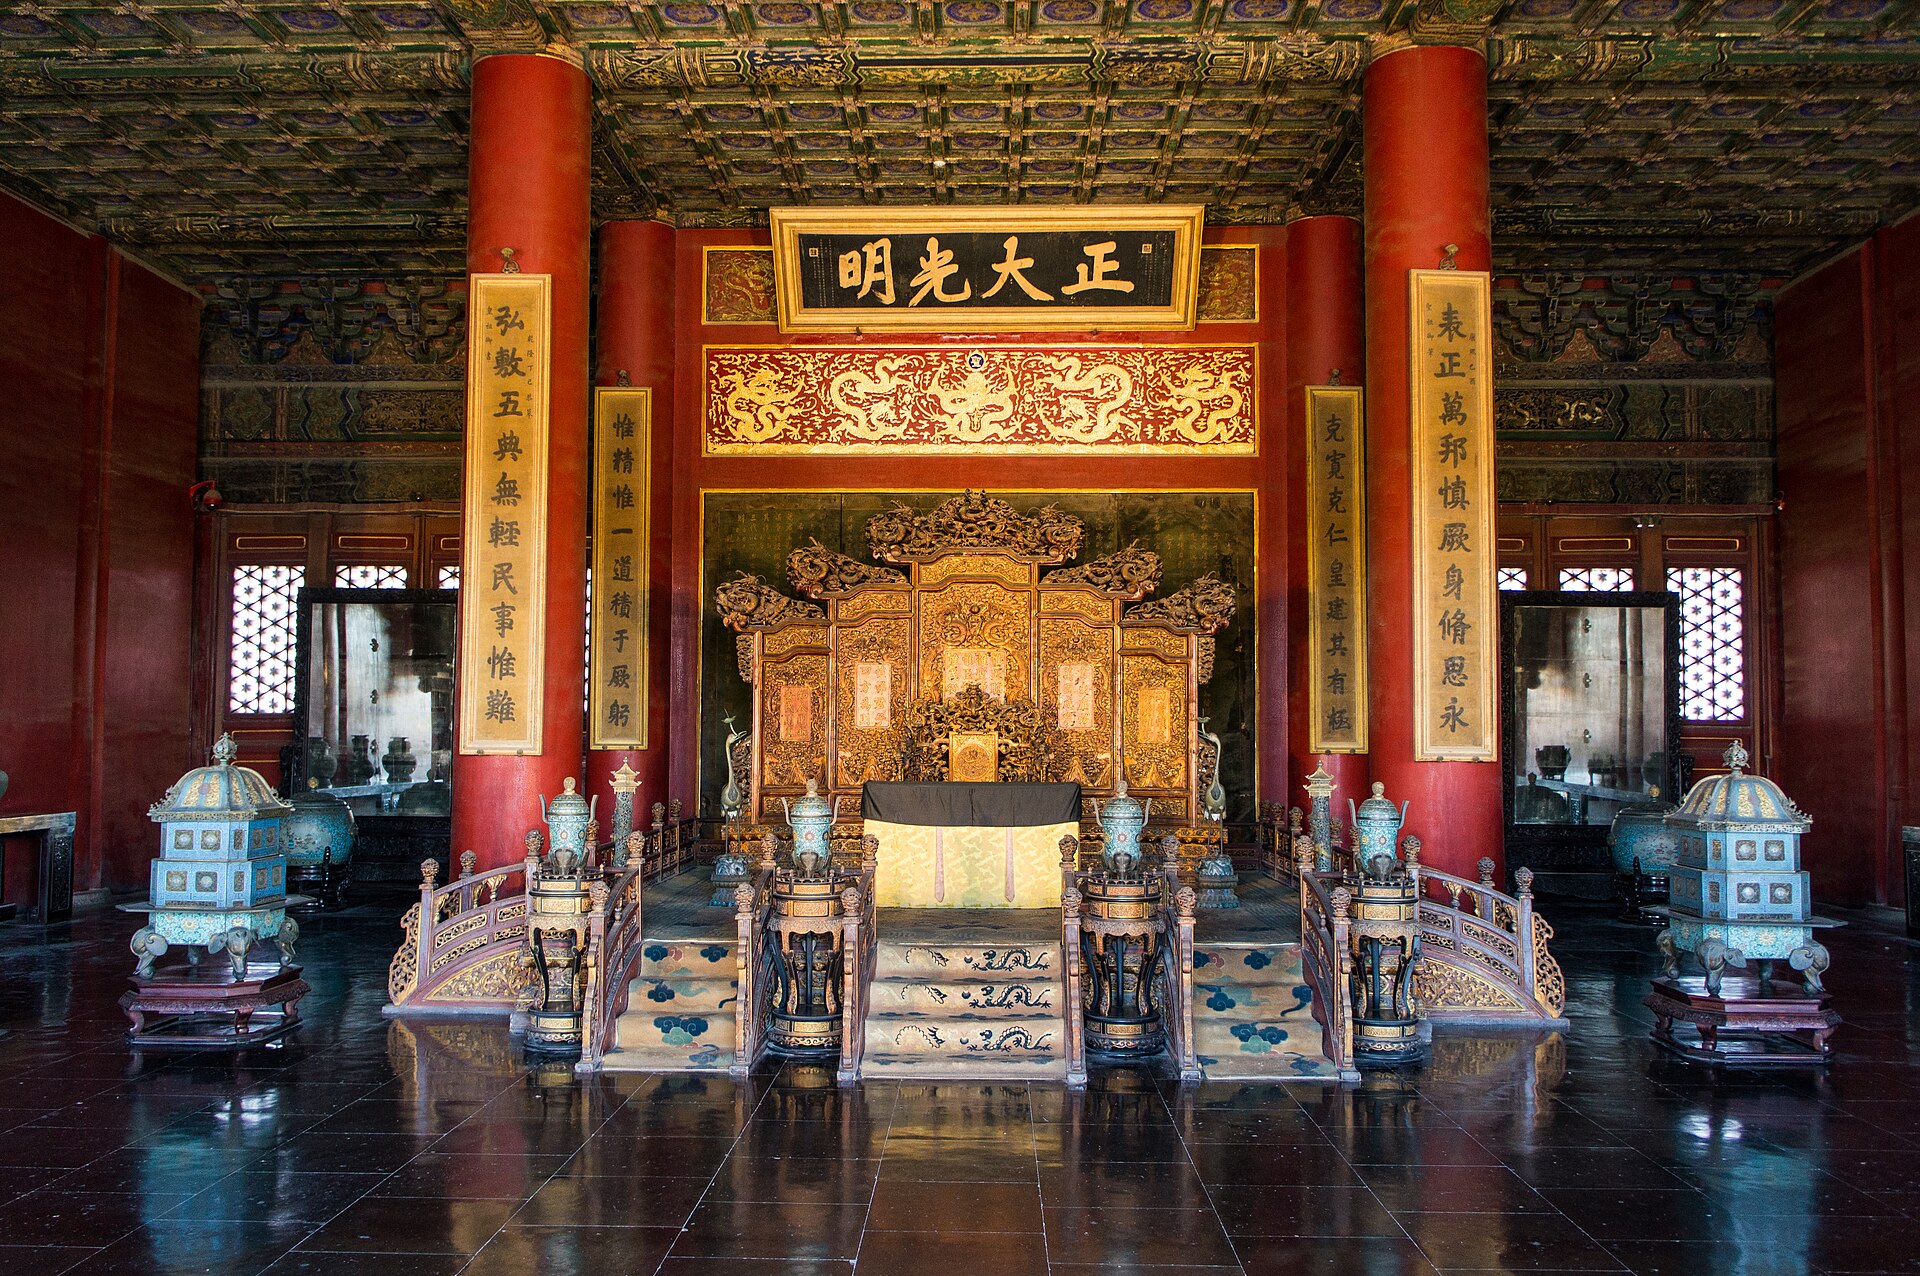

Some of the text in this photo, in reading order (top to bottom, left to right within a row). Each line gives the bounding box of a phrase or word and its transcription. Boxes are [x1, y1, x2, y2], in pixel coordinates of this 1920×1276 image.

[838, 236, 1135, 307] 正大光明
[485, 306, 526, 724] 弘敷五典無輕民事惟難
